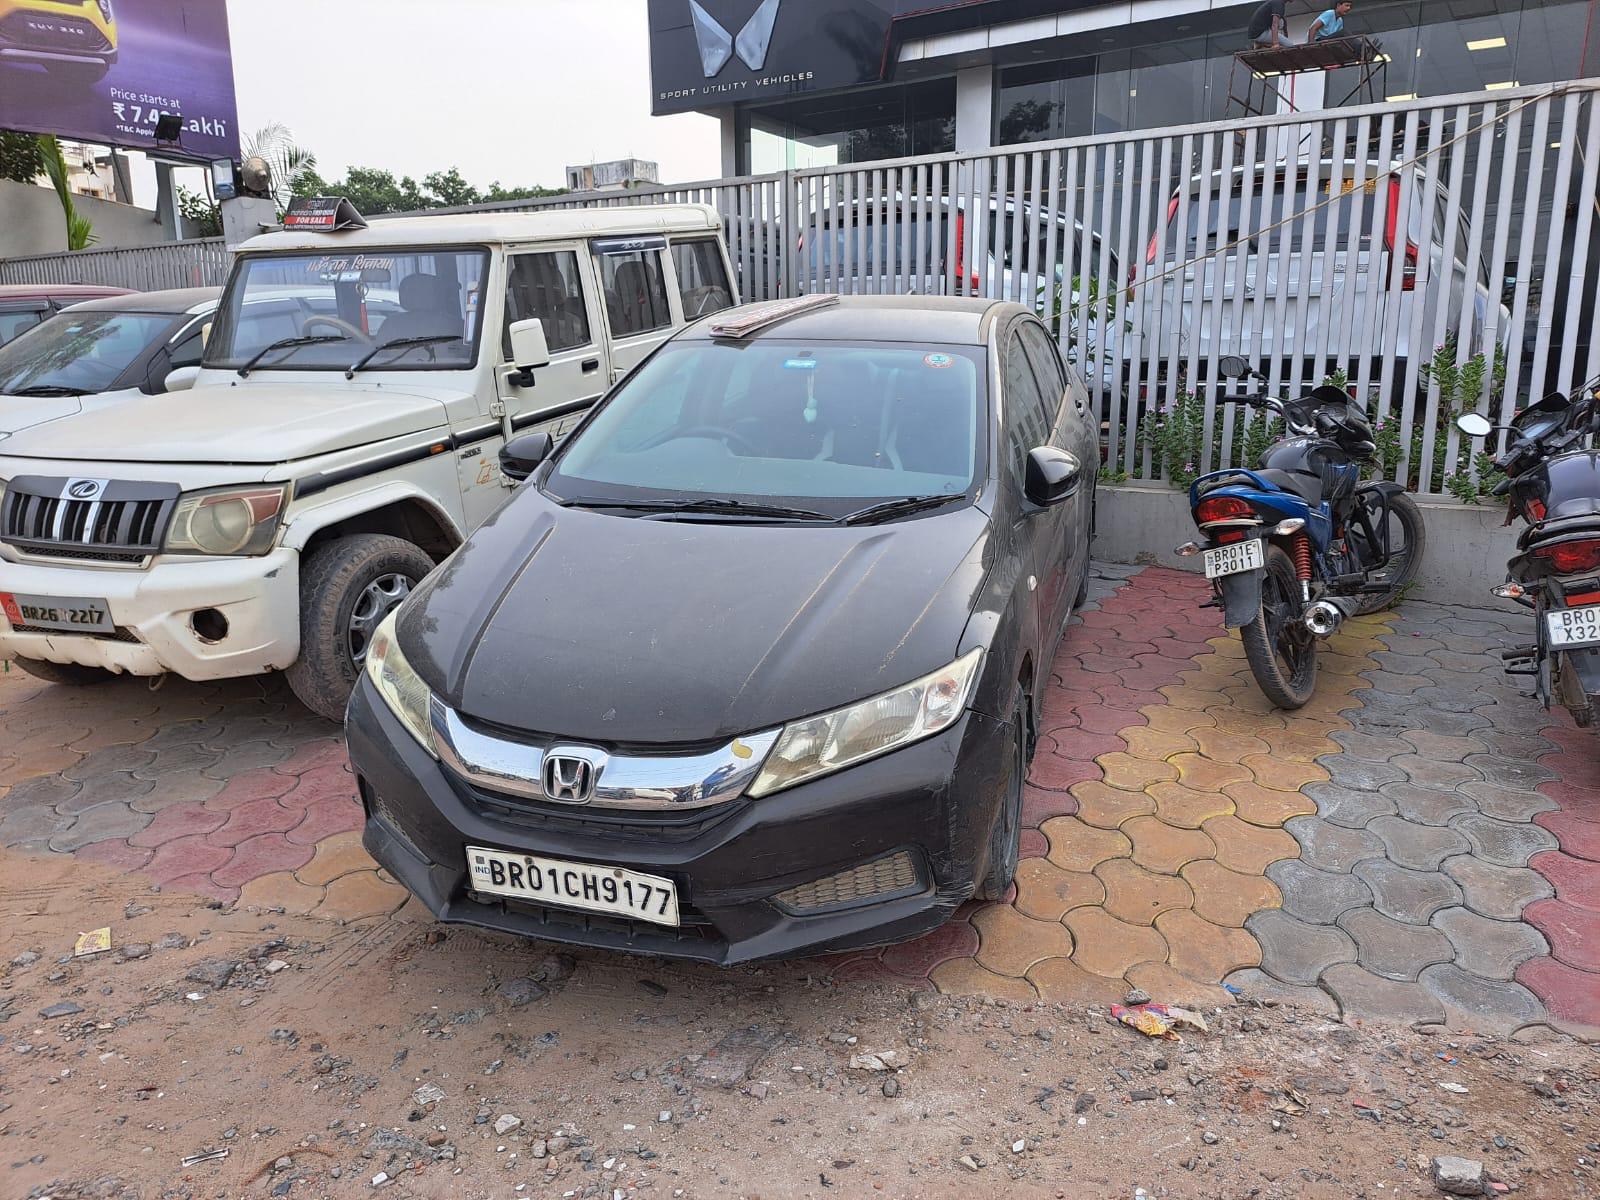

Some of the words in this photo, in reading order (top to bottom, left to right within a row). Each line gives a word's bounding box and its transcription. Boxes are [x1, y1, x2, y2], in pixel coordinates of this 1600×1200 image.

[660, 88, 697, 100] SPORT
[703, 81, 748, 94] UTILITY
[755, 71, 814, 86] VEHICLES
[110, 87, 137, 101] Price
[139, 93, 168, 106] starts
[170, 99, 181, 109] at
[130, 105, 170, 125] 7.4
[295, 216, 310, 224] FOR
[309, 216, 327, 224] SALE
[1214, 543, 1253, 563] BR01E
[1214, 556, 1253, 575] P3011
[21, 605, 59, 621] BR26
[68, 608, 105, 624] 2217
[1562, 609, 1600, 626] BR0
[1564, 624, 1600, 641] X32
[474, 865, 490, 875] IND
[489, 858, 671, 915] BR01CH9177
